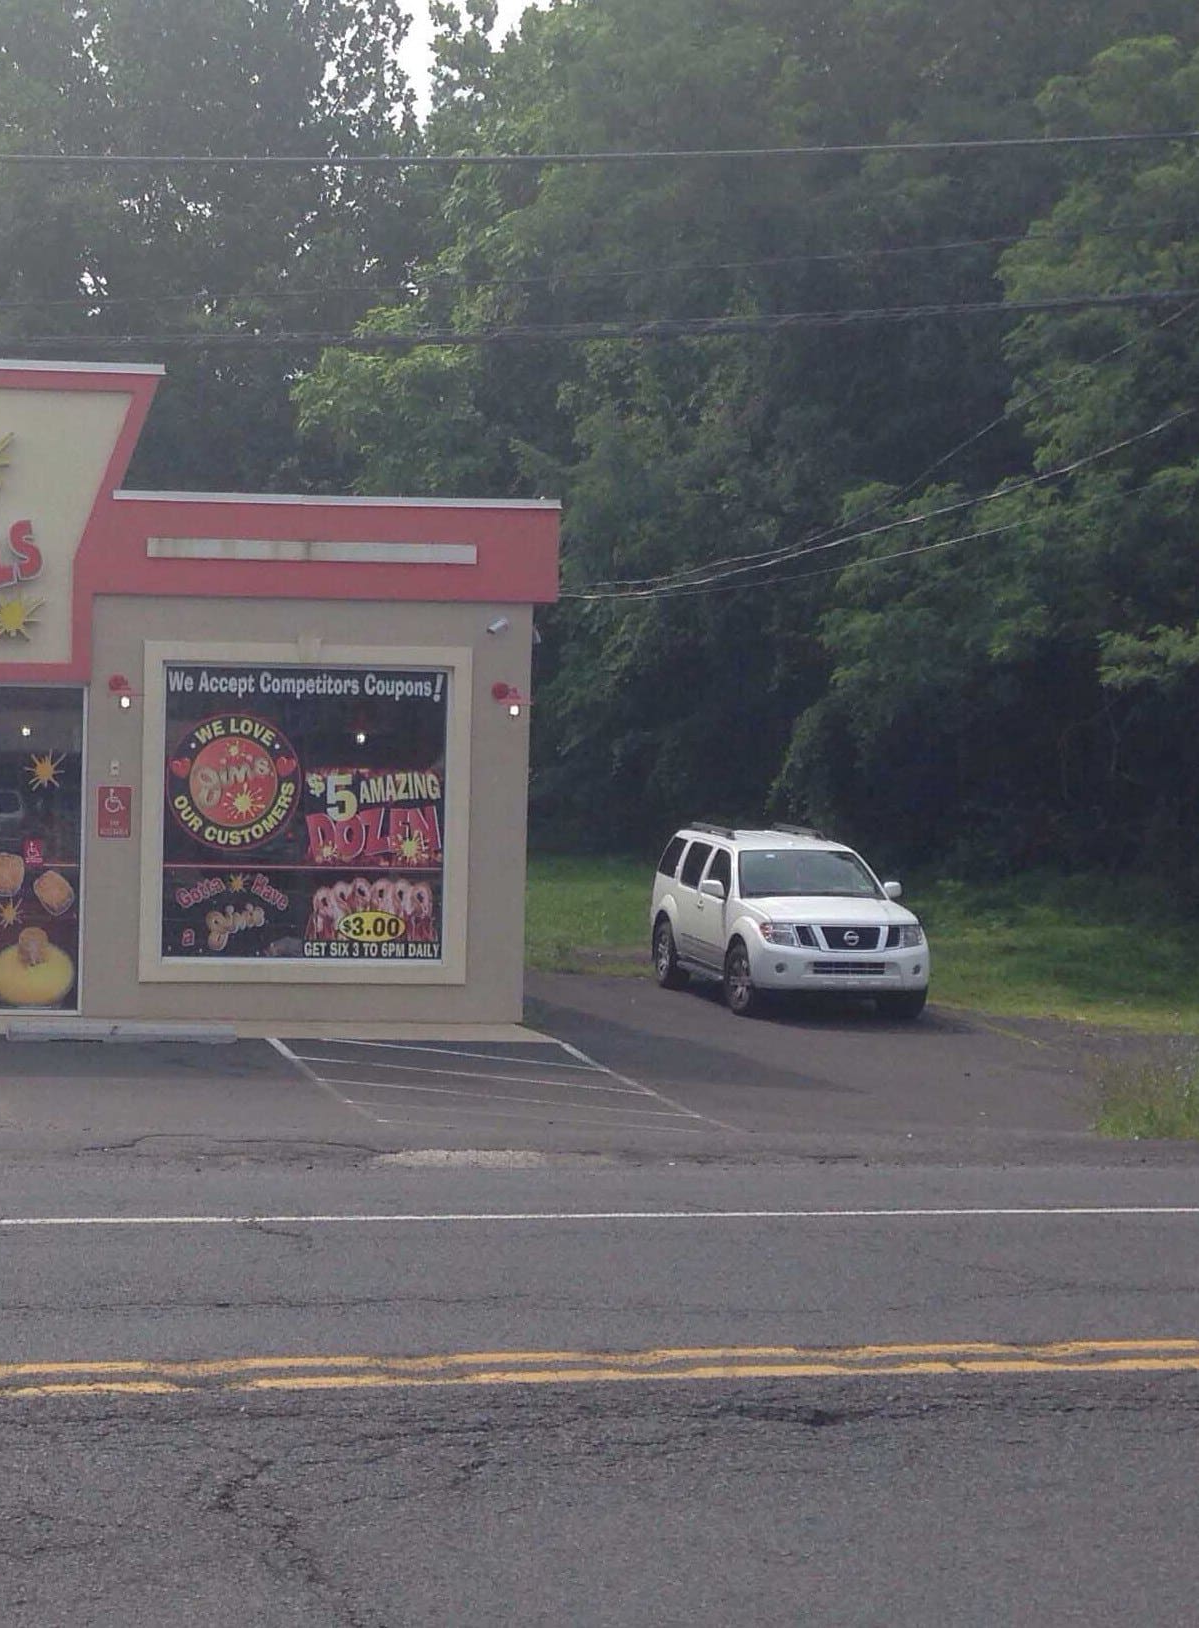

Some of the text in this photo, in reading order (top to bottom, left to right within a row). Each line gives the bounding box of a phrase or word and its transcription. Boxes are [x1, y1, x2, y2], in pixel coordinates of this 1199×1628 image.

[168, 671, 444, 702] We Accept Competitors Coupons!
[194, 718, 276, 747] WE LOVE
[305, 771, 358, 821] $5
[360, 772, 441, 804] AMAZING
[174, 782, 295, 846] OUR CUSTOMERS
[306, 806, 441, 858] DOZEN
[342, 917, 400, 937] $3.00
[304, 942, 440, 958] GET SIX 3 TO 6PM DAILY
